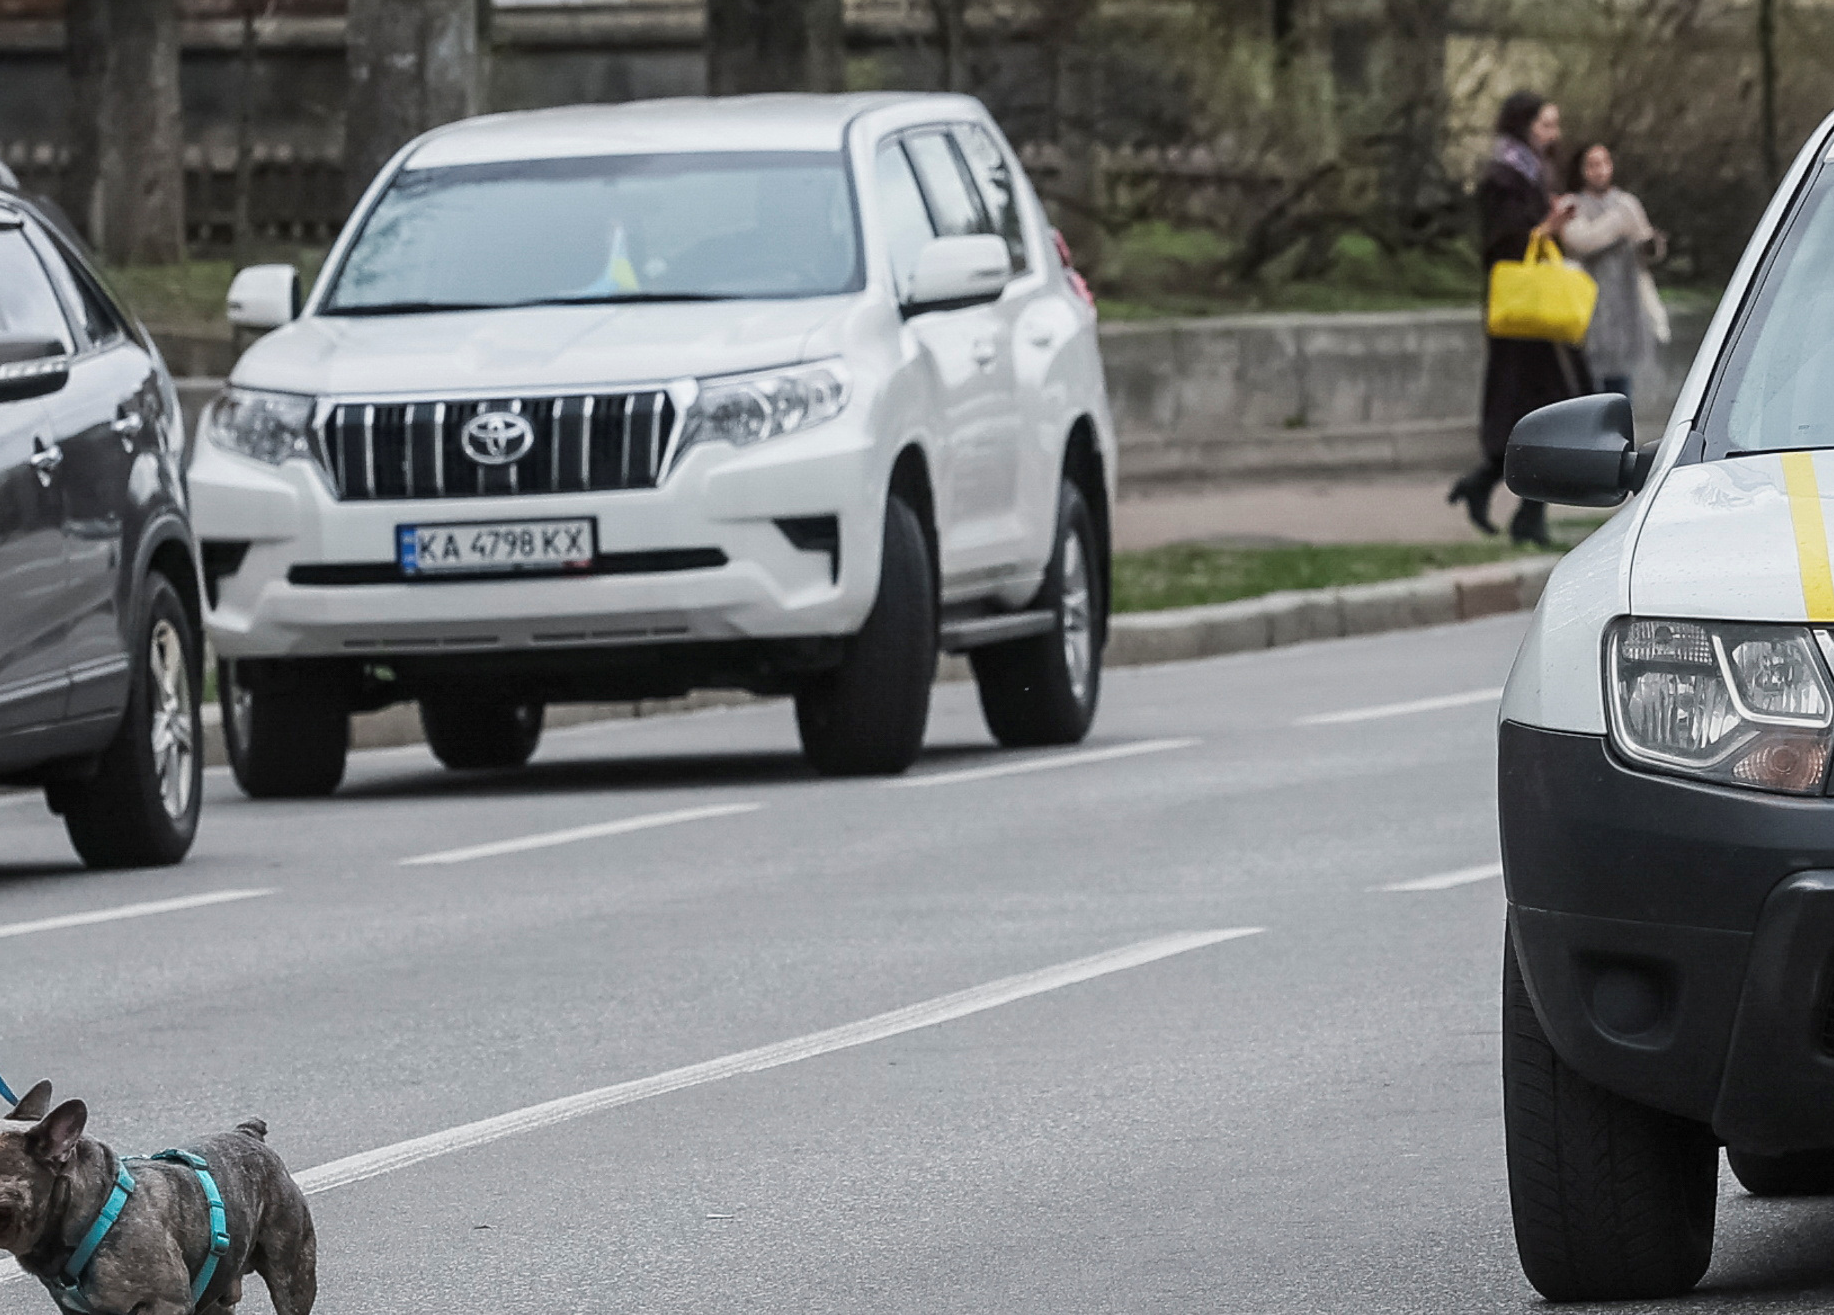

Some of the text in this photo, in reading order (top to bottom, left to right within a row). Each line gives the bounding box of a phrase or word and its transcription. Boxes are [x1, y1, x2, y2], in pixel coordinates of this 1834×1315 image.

[419, 533, 461, 561] KA
[470, 529, 535, 557] 4798
[542, 526, 583, 555] KX
